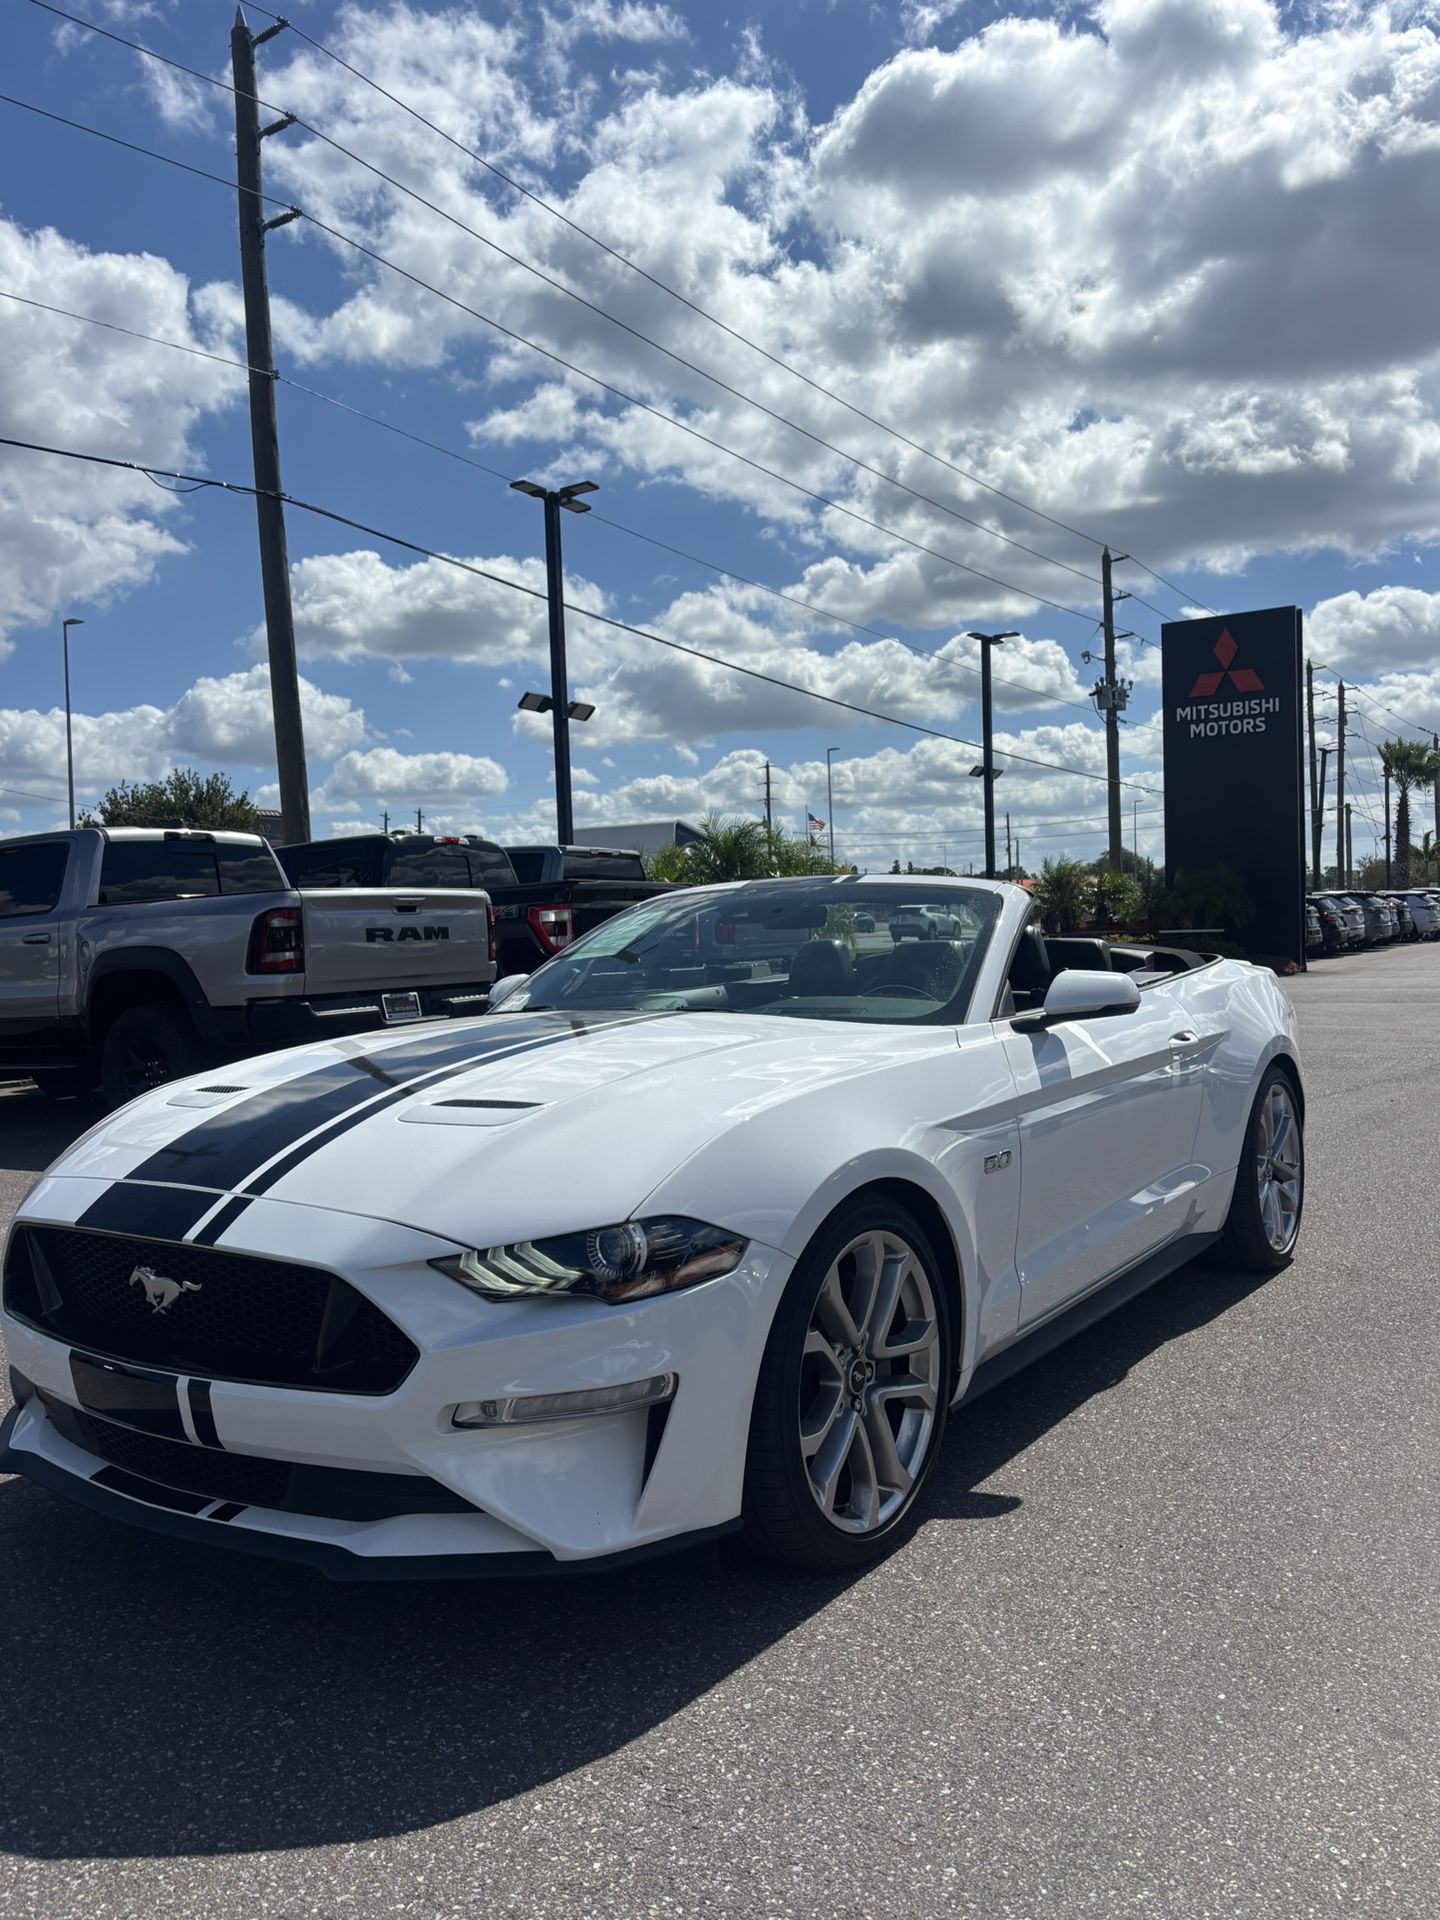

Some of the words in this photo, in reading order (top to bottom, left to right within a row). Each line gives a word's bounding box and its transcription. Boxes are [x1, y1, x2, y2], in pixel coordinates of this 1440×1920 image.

[1176, 697, 1280, 722] MITSUBISHI
[1190, 717, 1266, 738] MOTORS
[365, 926, 450, 943] RAM
